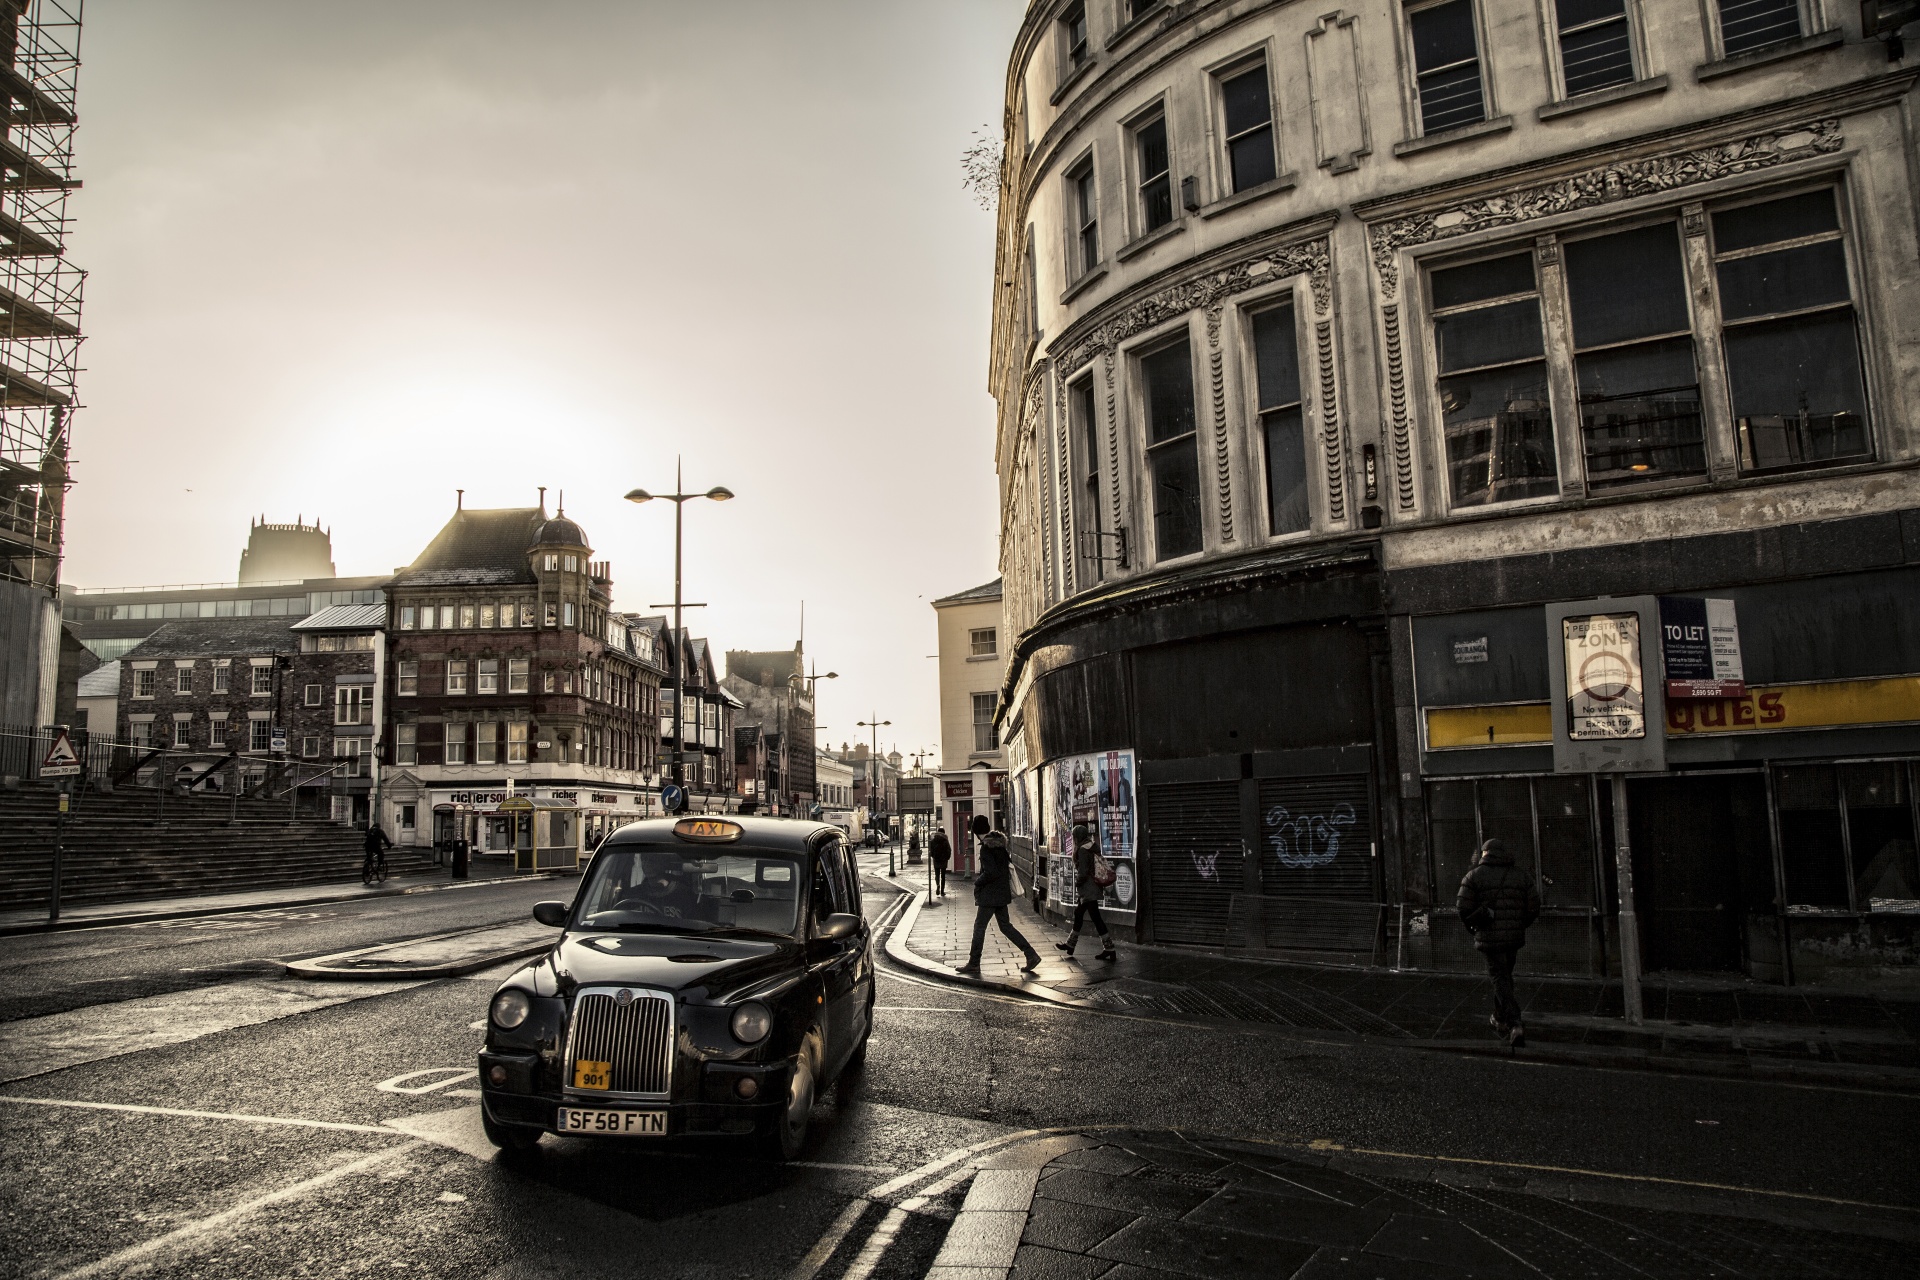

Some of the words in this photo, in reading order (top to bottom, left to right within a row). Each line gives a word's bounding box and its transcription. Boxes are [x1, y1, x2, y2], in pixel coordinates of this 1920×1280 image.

[1573, 621, 1633, 632] PEDESTRIAN
[1664, 625, 1682, 641] TO
[1685, 626, 1705, 641] LET
[1578, 631, 1629, 648] ZONE
[1598, 704, 1633, 712] vehicles
[1586, 719, 1616, 729] Except
[1619, 718, 1631, 726] for
[1578, 729, 1606, 737] permit
[1608, 727, 1641, 736] holders
[552, 789, 578, 799] richer
[687, 823, 725, 836] TAXI
[583, 1073, 604, 1086] 901
[570, 1111, 619, 1131] SF58
[625, 1113, 664, 1132] FTN
